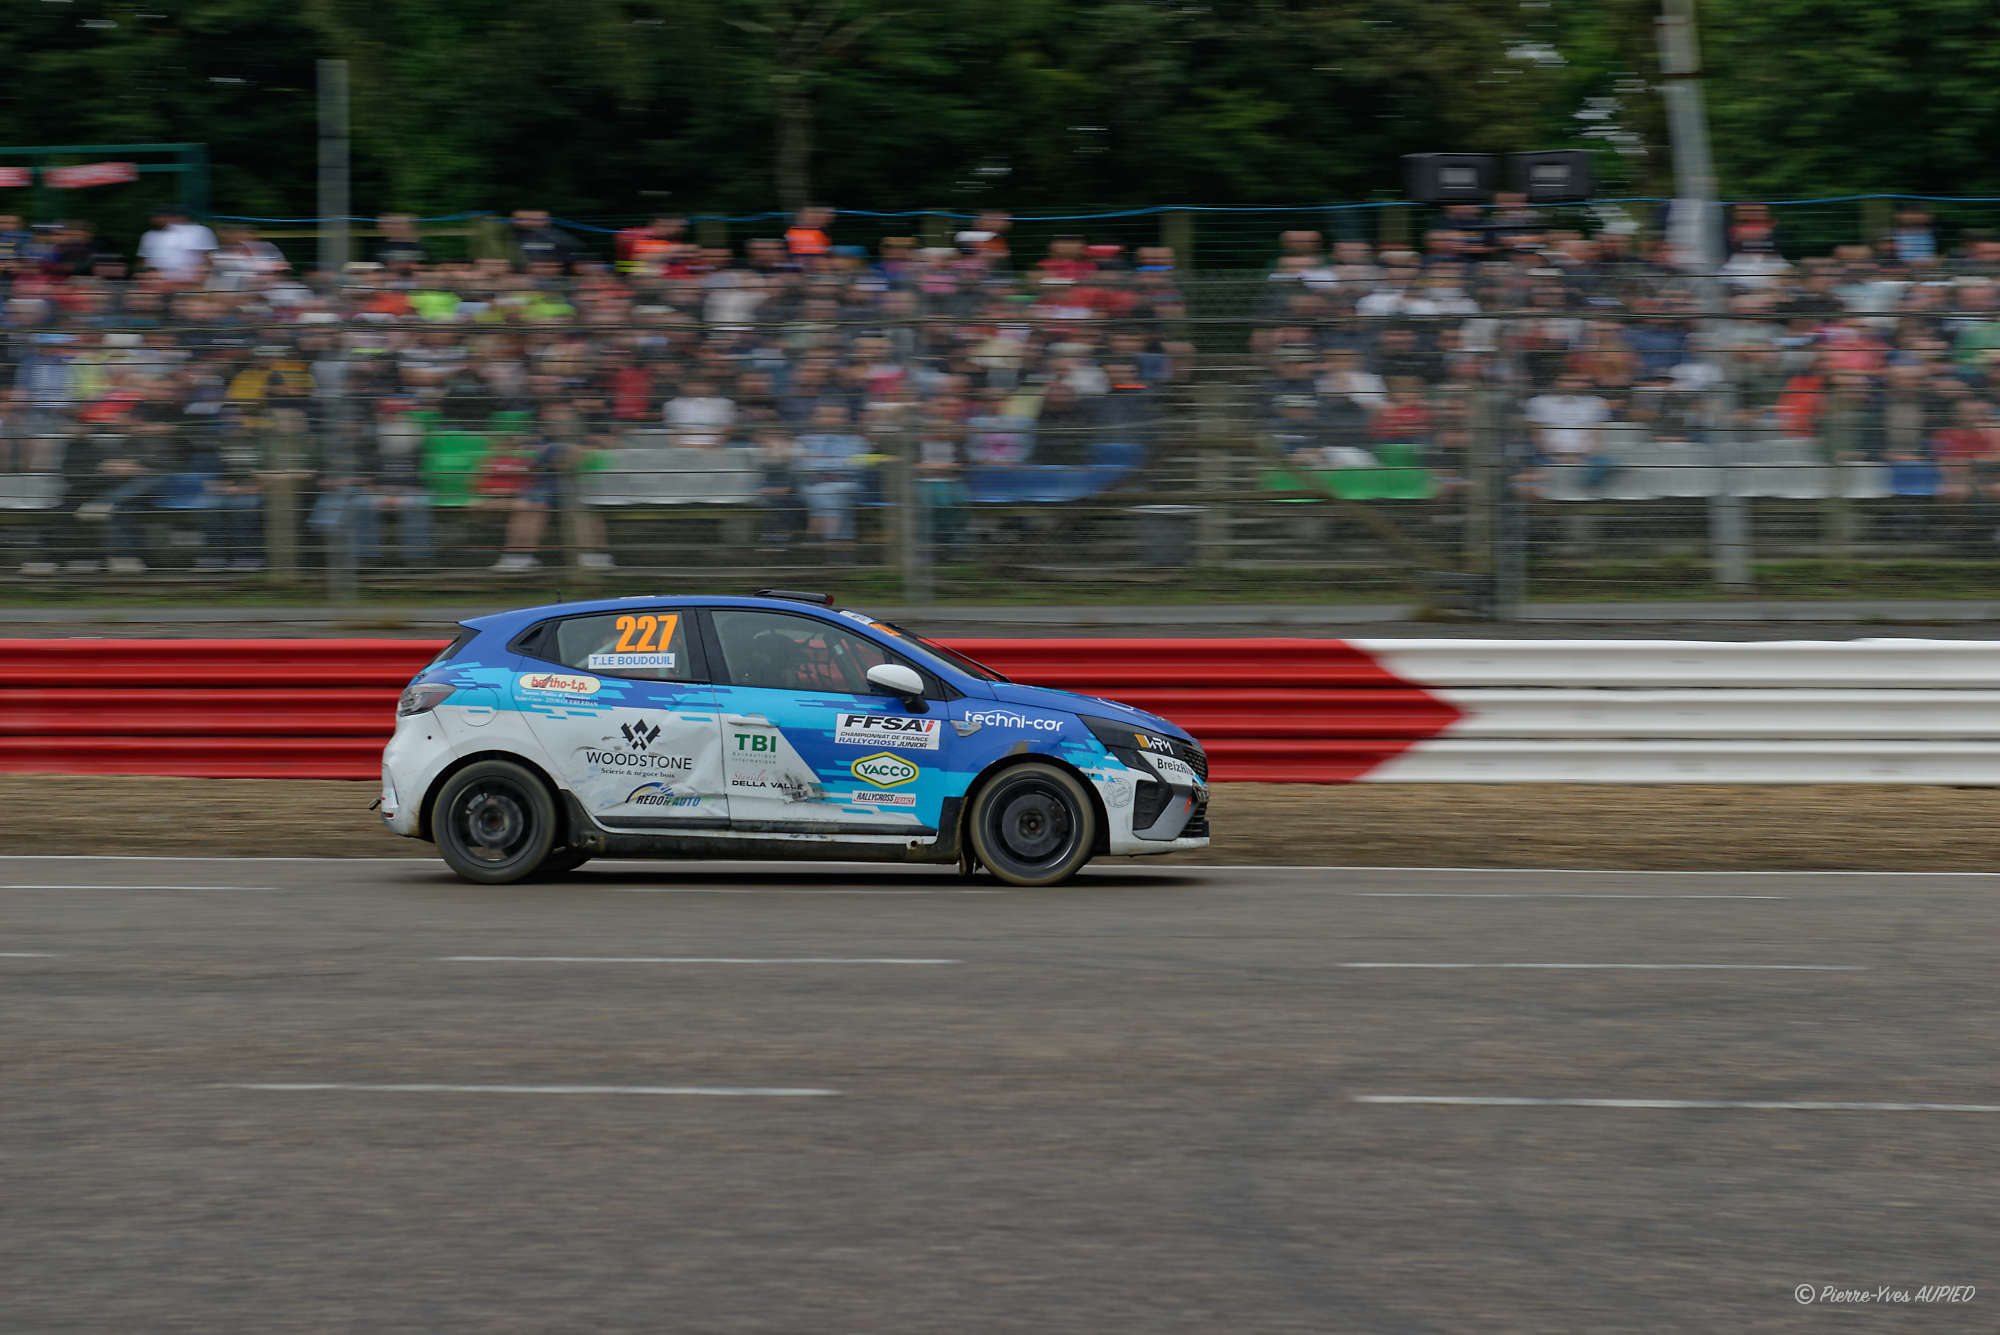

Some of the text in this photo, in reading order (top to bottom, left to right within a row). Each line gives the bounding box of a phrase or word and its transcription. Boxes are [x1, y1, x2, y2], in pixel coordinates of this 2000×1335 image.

[615, 614, 678, 652] 227
[617, 656, 673, 665] BOUDOUIL
[844, 715, 923, 732] FFSA
[965, 711, 1064, 731] techni-car
[839, 737, 896, 746] RALLYCROSS
[840, 732, 889, 740] CHAMPIONNAT
[734, 733, 777, 753] TBI
[586, 751, 692, 770] WOODSTONE
[862, 764, 911, 777] YACCO
[732, 780, 767, 788] DELLA
[857, 792, 895, 802] RALLYCROSS
